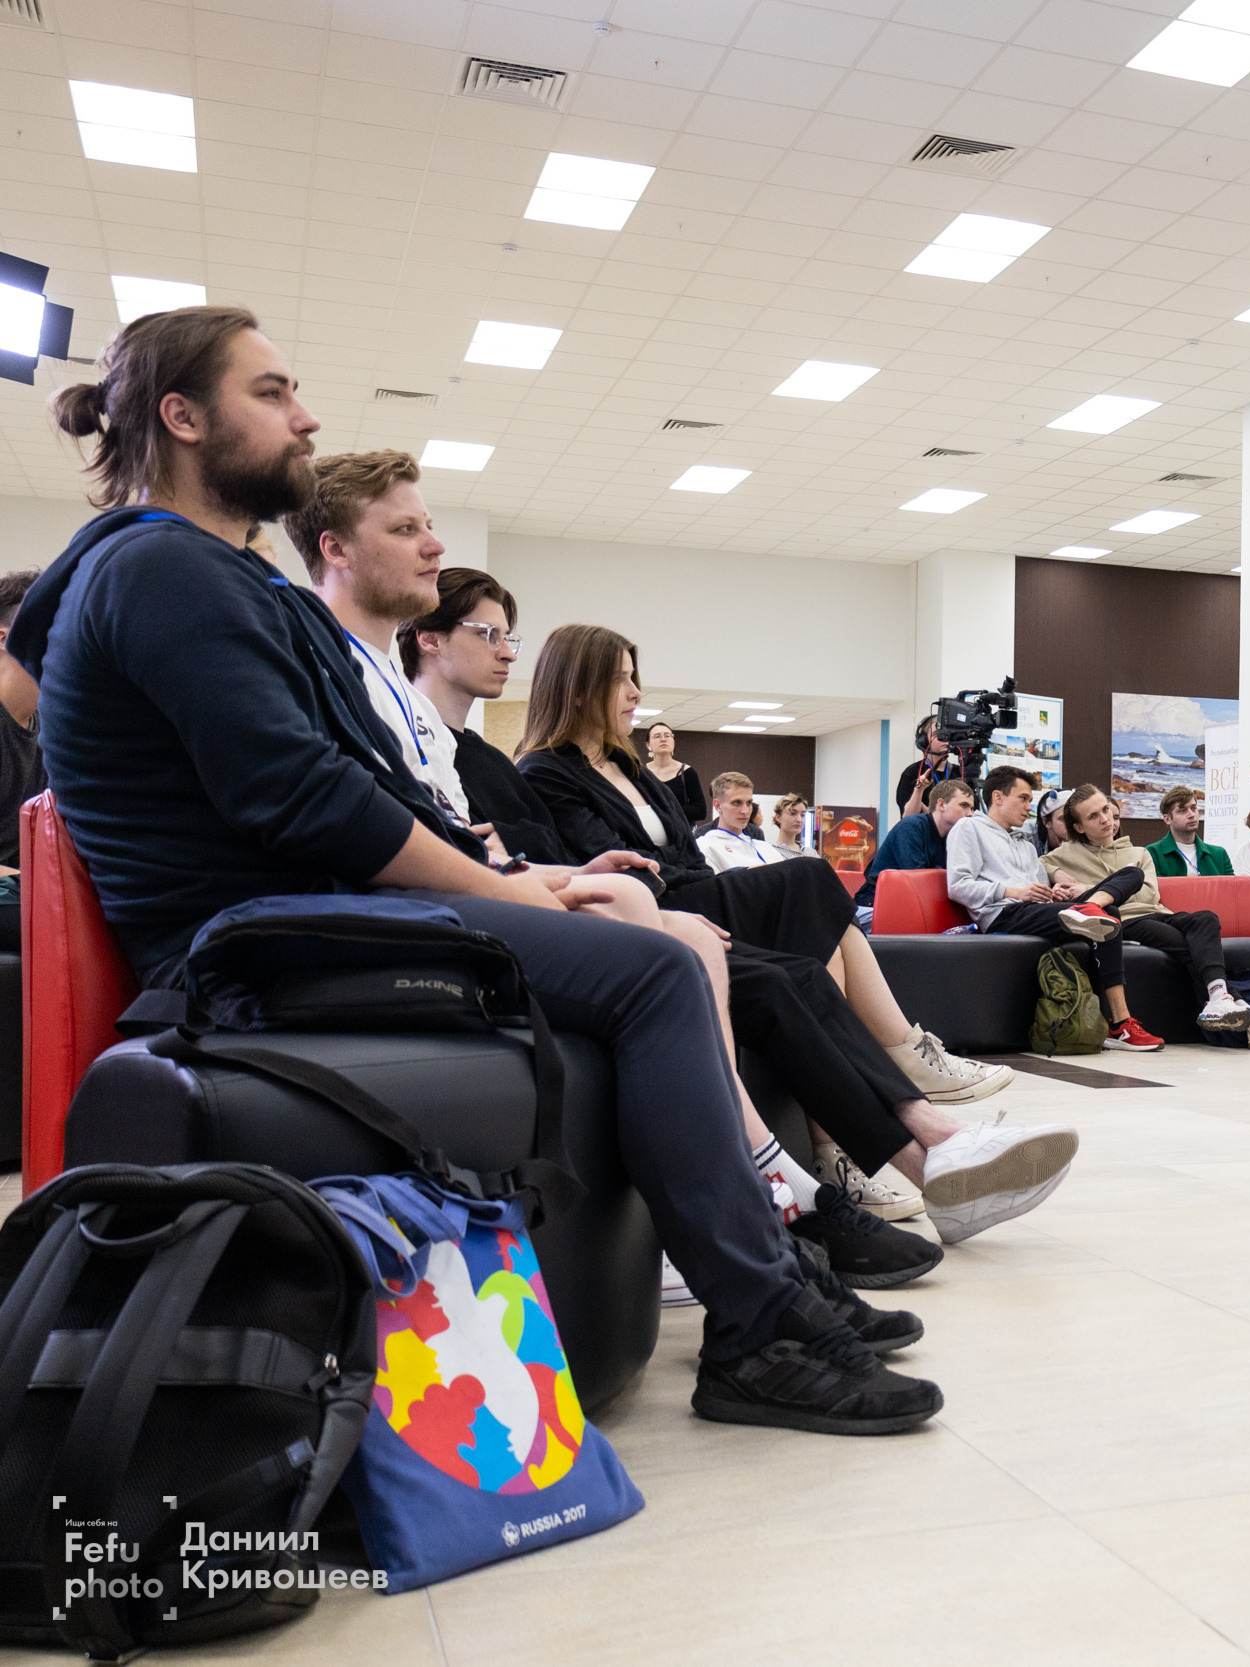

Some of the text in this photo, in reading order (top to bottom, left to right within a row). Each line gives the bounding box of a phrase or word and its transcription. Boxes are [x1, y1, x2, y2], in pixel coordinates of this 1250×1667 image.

[1209, 761, 1239, 791] ВСЁ
[1208, 794, 1223, 806] ЧТО
[394, 979, 464, 998] DAKINE
[520, 1504, 586, 1538] RUSSIA 2017
